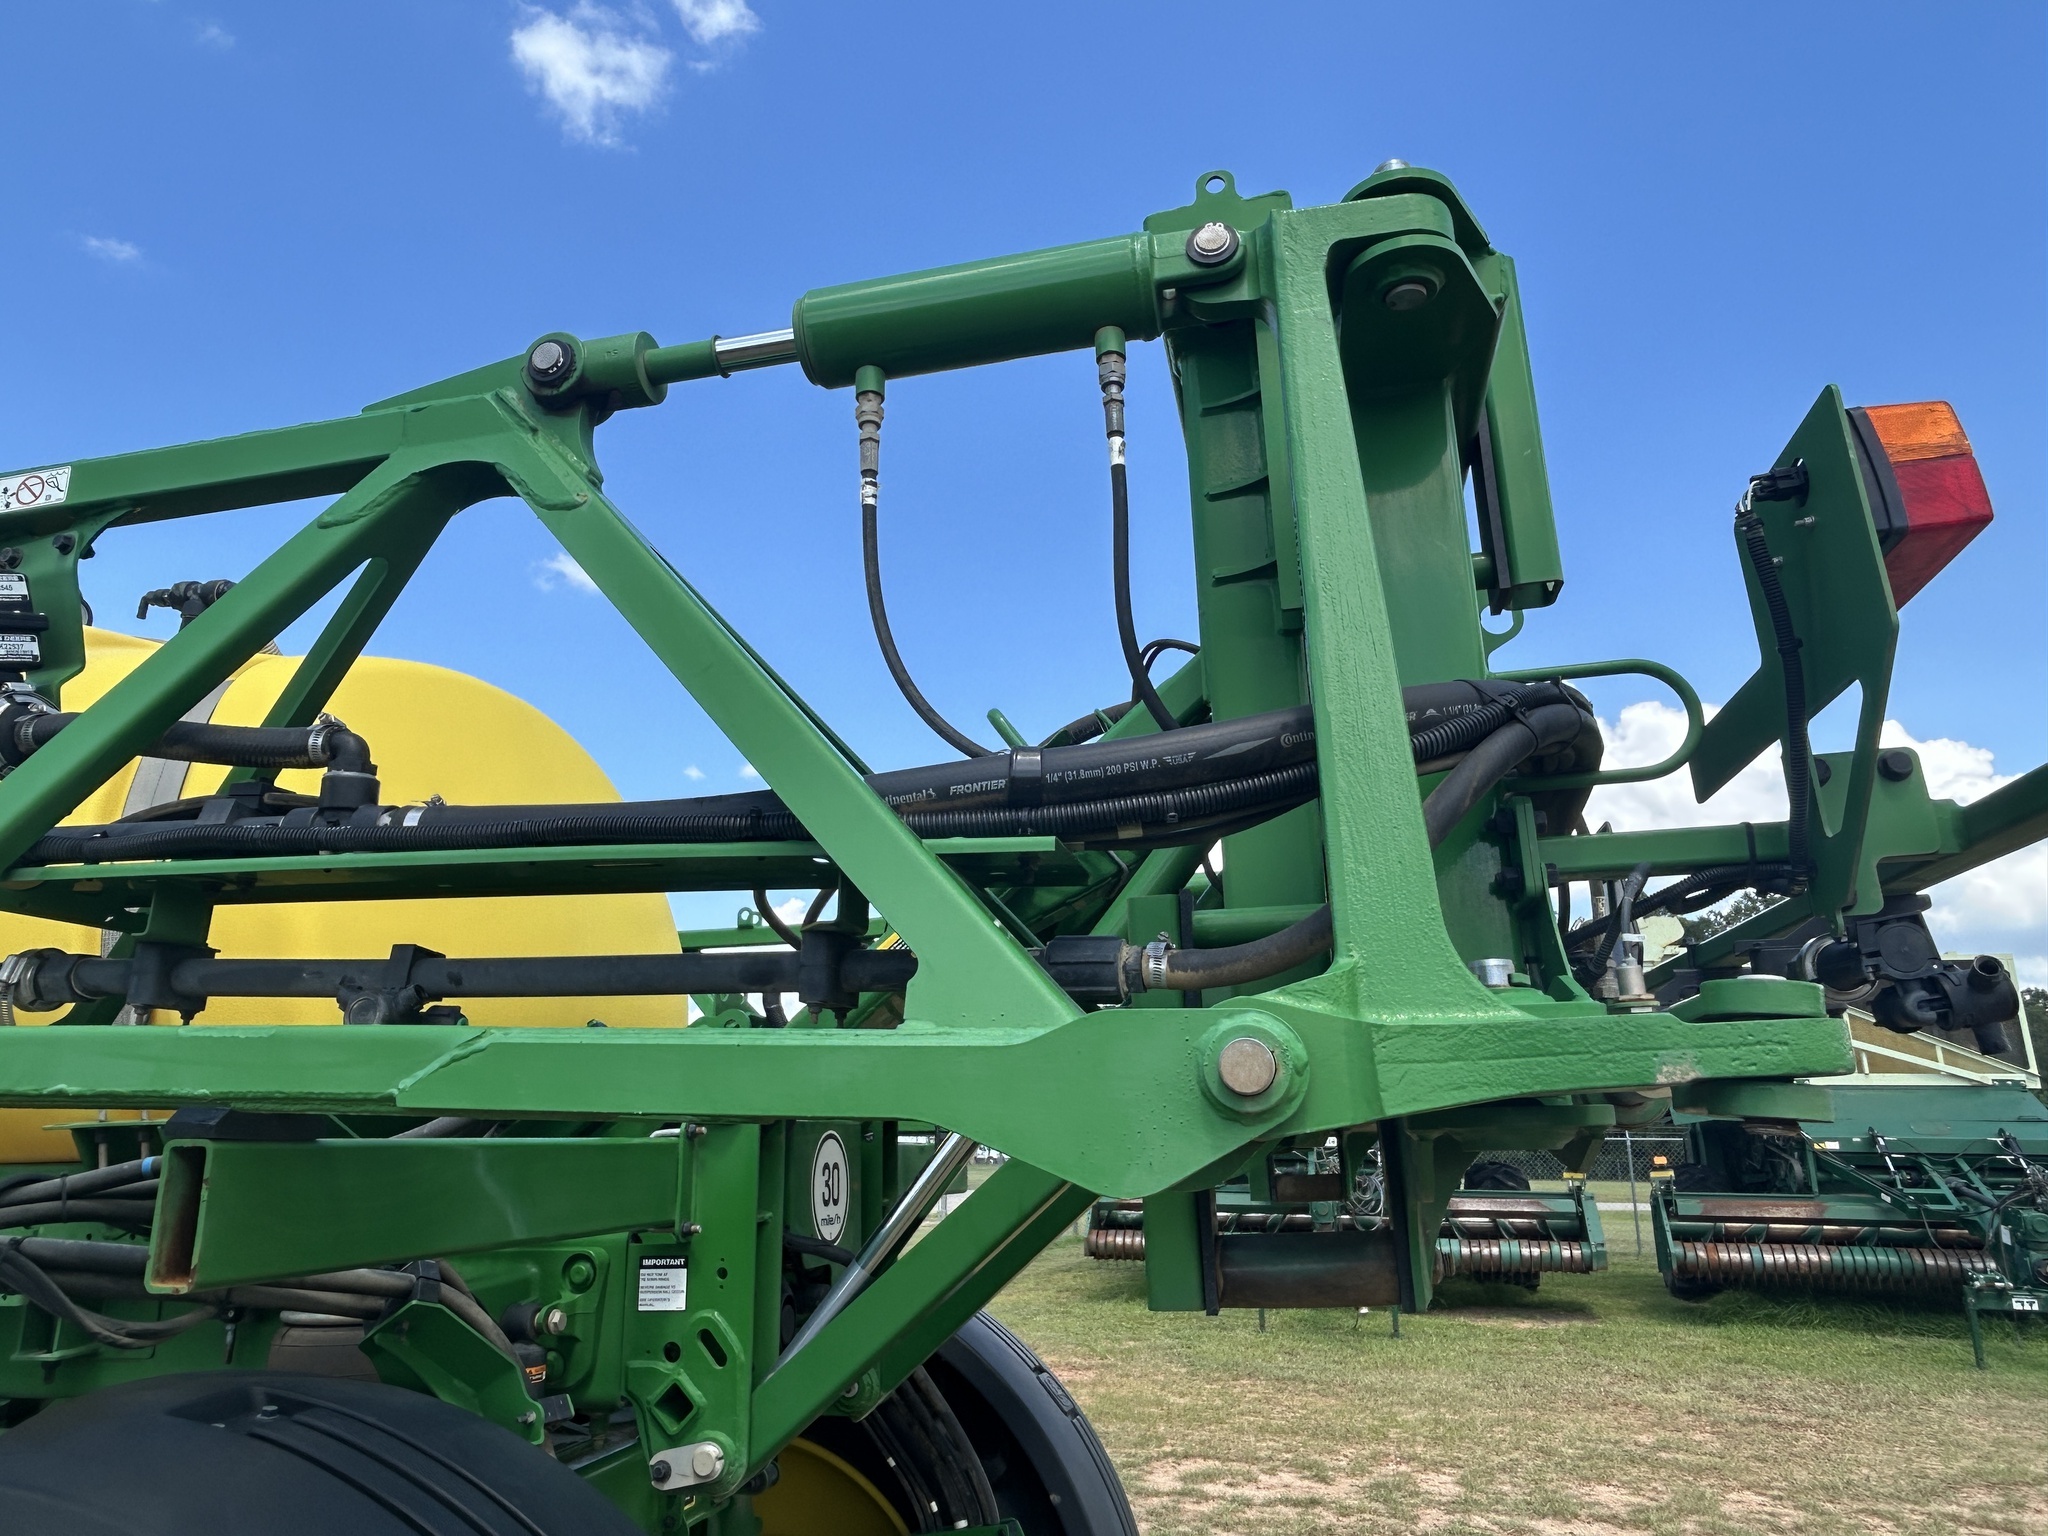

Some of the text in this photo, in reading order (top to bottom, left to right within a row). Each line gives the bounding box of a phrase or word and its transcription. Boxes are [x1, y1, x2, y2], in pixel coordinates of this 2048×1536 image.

[1280, 731, 1315, 748] Contin
[885, 789, 926, 805] tinental
[950, 779, 1006, 795] FRONTIER
[1064, 767, 1104, 783] (31.8mm)
[1106, 764, 1122, 776] 200
[1124, 761, 1139, 773] PSI
[1140, 758, 1161, 770] W.P.
[822, 1162, 840, 1207] 30
[642, 1258, 686, 1266] IMPORTANT
